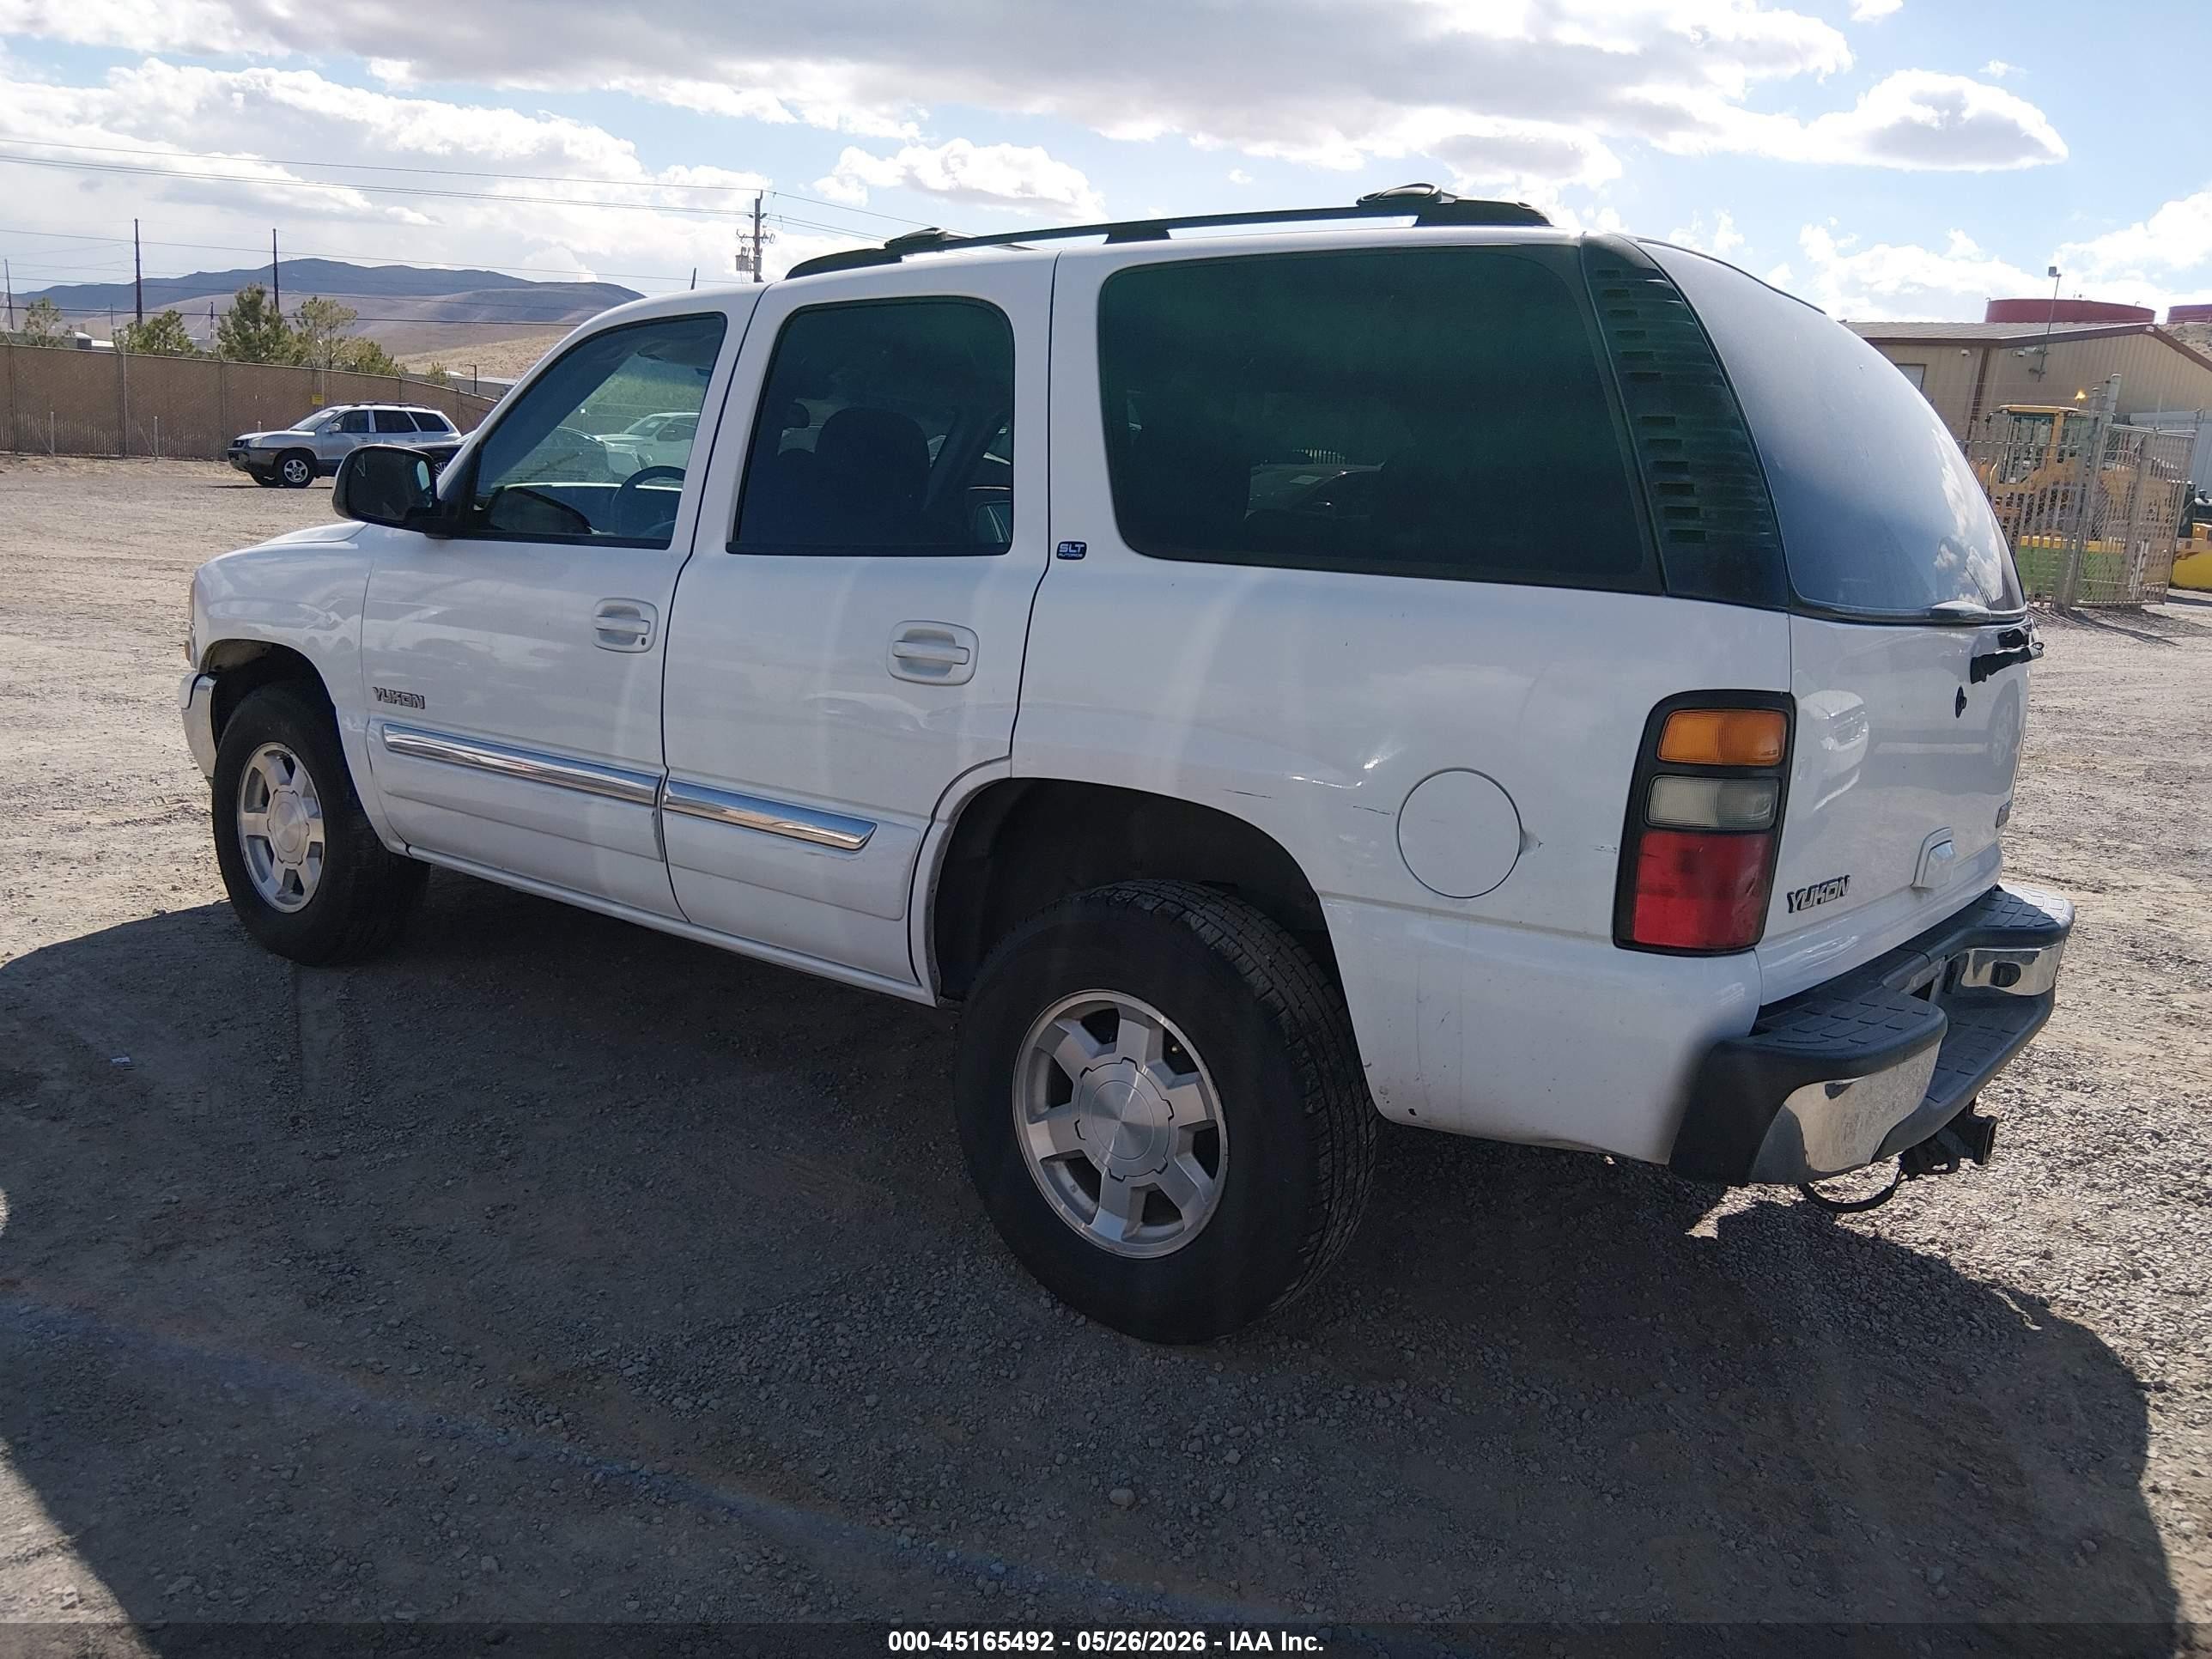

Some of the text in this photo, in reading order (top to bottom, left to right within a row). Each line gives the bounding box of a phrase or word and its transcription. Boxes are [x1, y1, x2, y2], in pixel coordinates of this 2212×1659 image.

[1058, 543, 1085, 553] SLT
[372, 686, 426, 709] YUKON
[1786, 874, 1850, 914] YUKON
